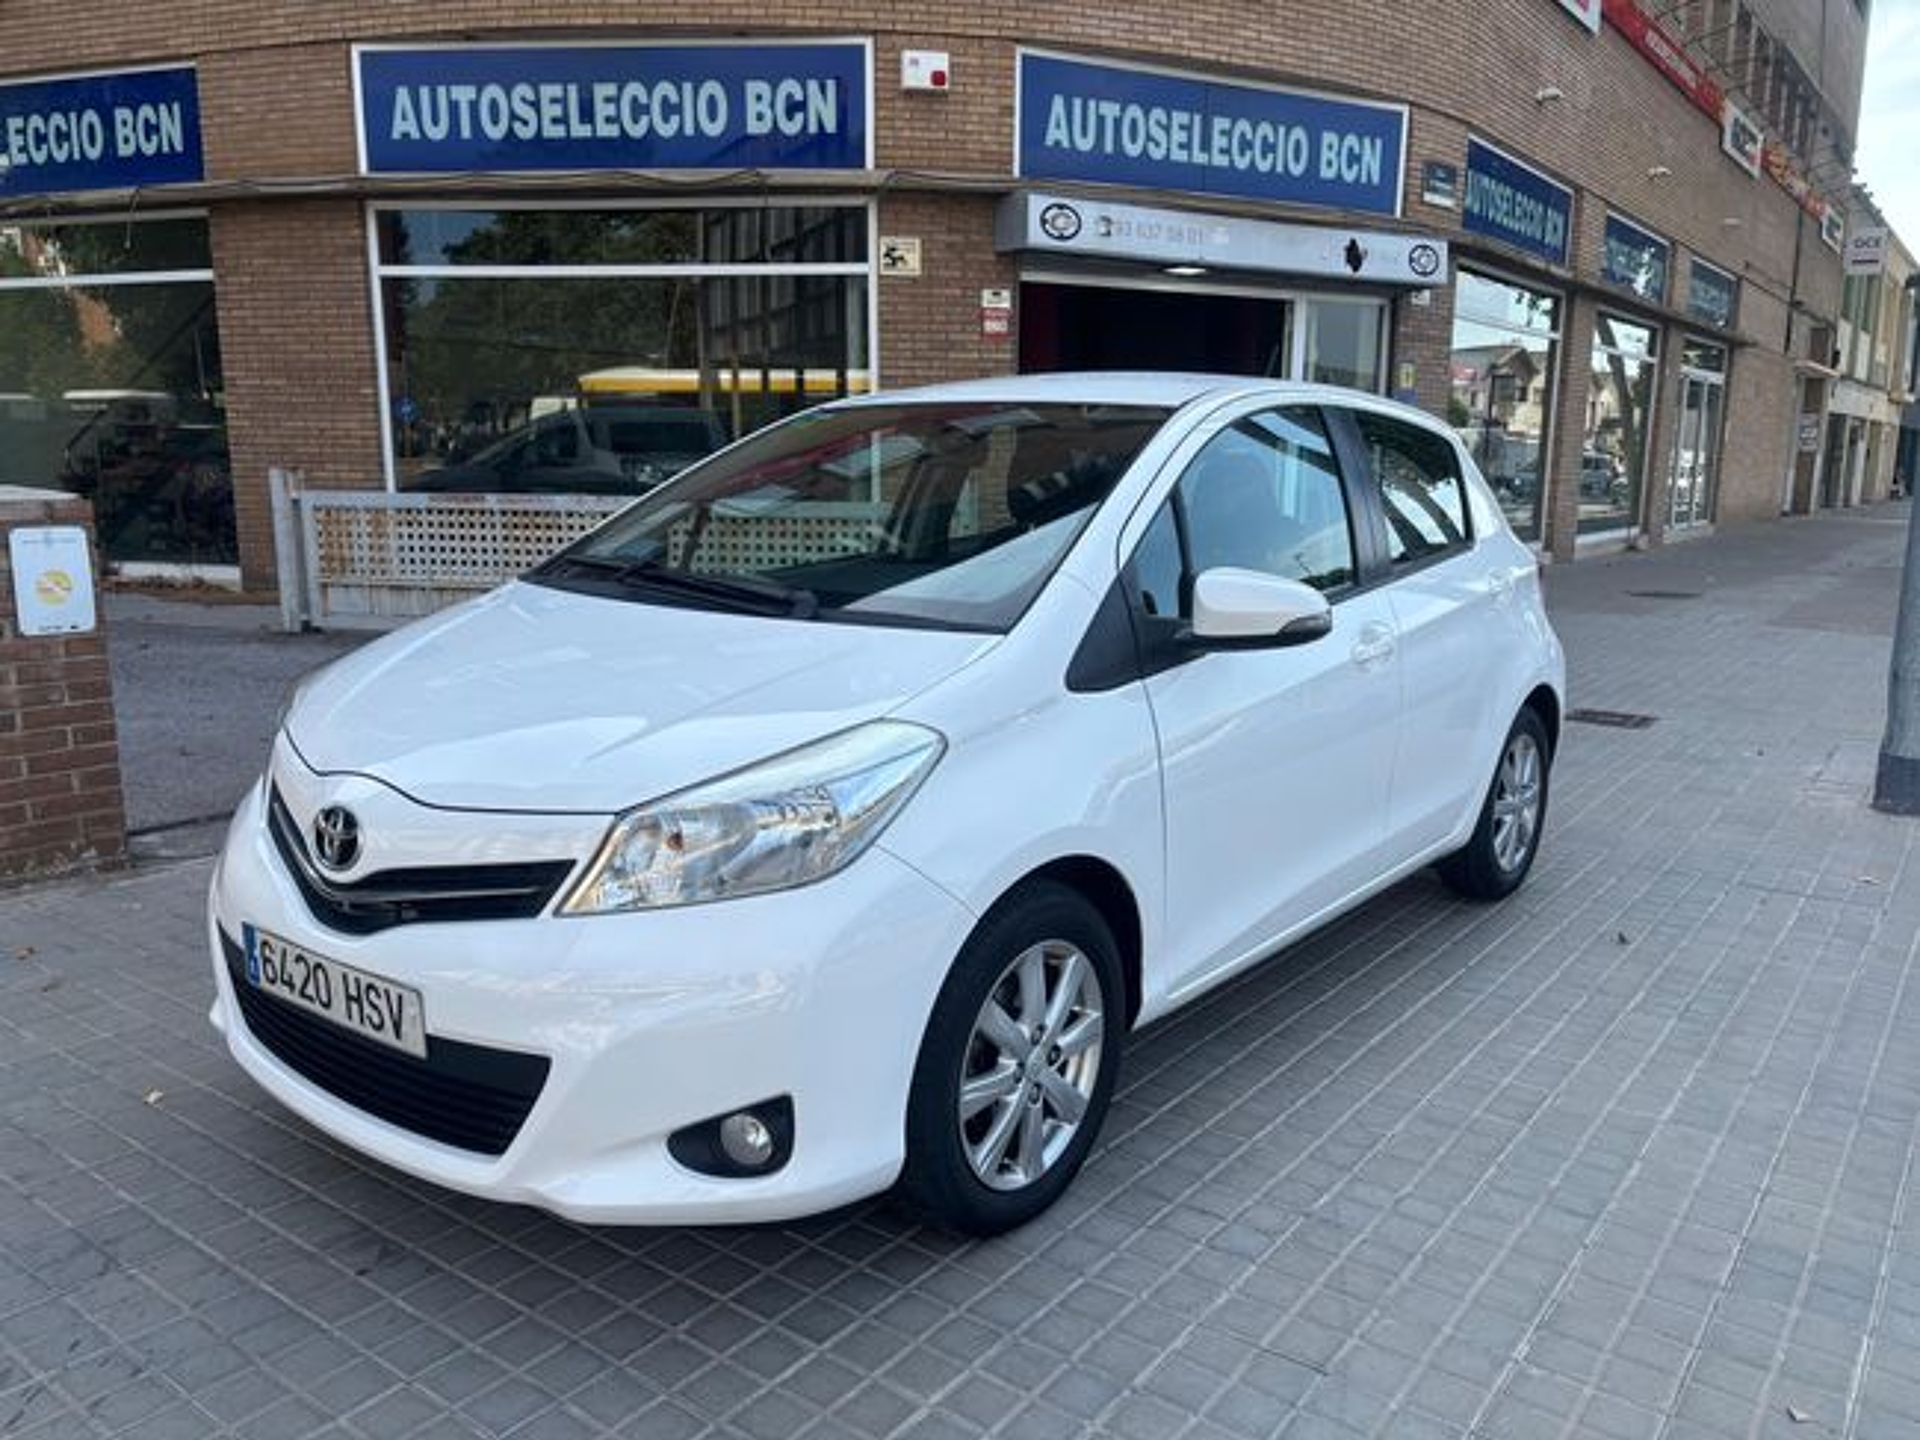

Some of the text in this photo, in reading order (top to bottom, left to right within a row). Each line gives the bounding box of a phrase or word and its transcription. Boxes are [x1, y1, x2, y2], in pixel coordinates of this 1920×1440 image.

[114, 101, 184, 157] BCN
[391, 78, 838, 140] AUTOSELECCIO BCN
[1045, 94, 1382, 186] AUTOSELECCIO BCN
[260, 940, 403, 1040] 6420 HSV
